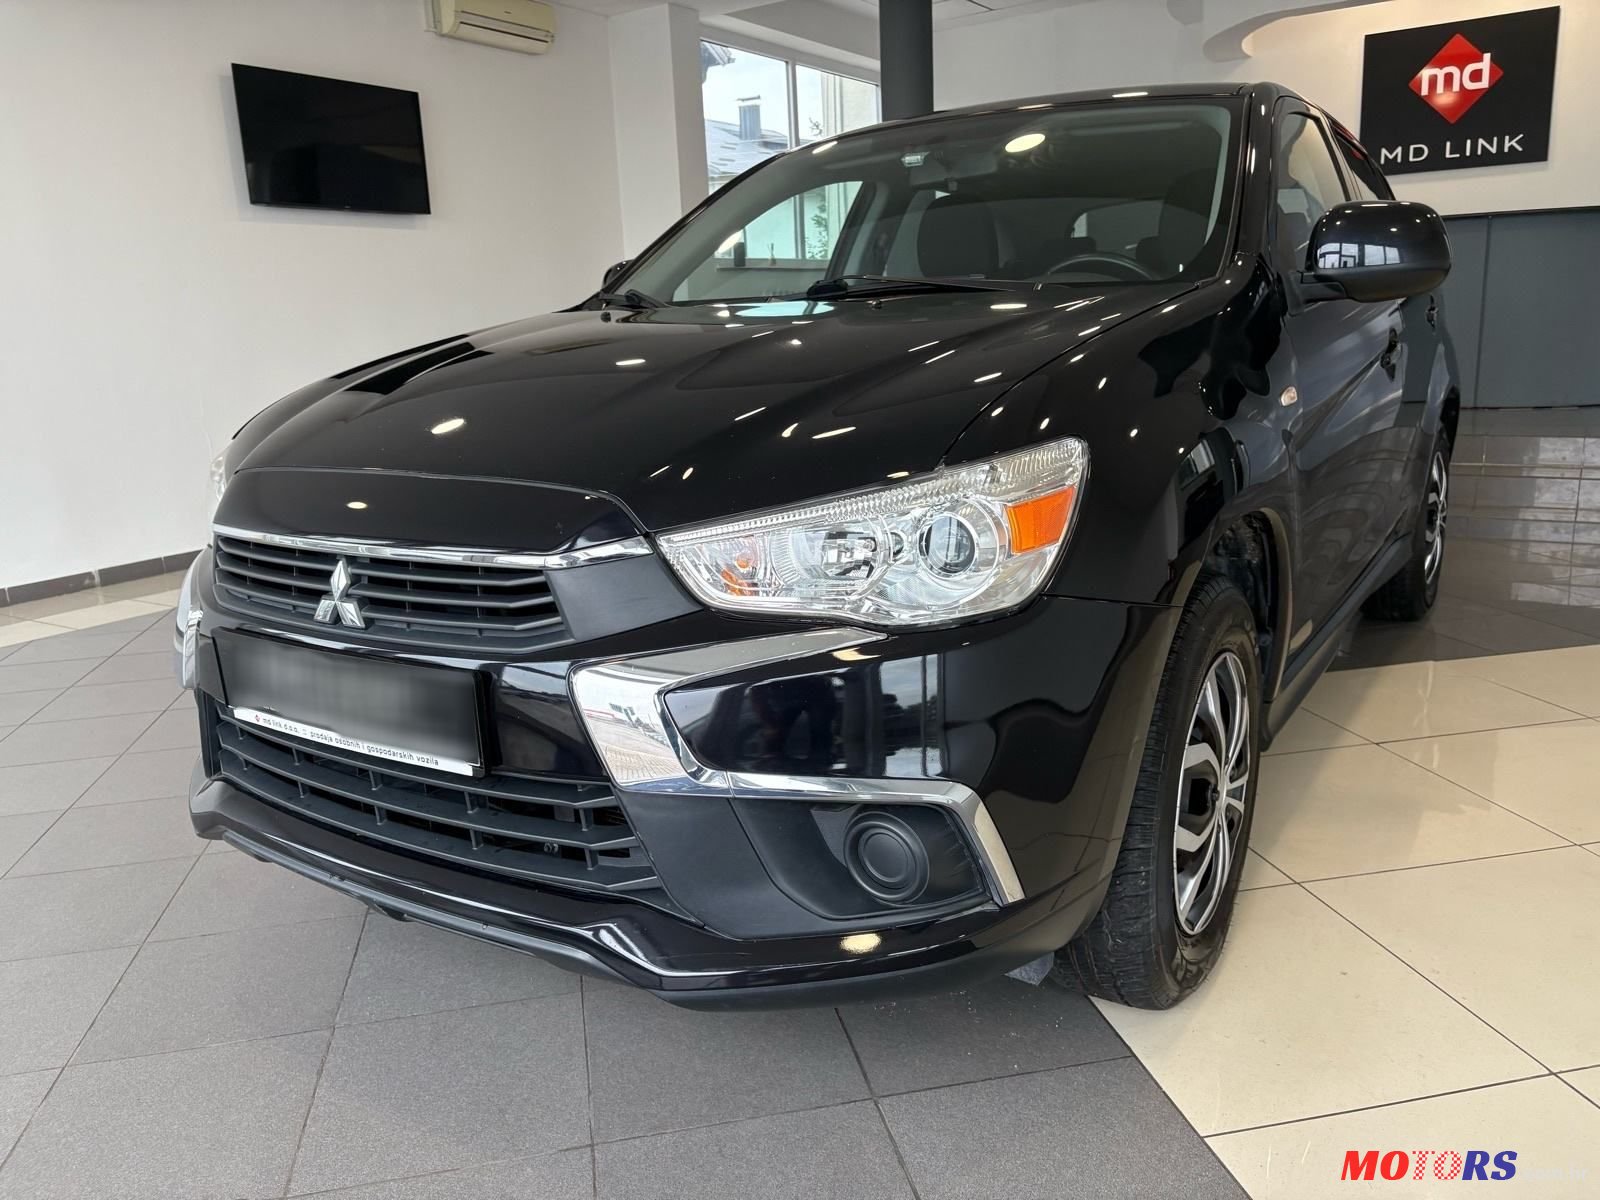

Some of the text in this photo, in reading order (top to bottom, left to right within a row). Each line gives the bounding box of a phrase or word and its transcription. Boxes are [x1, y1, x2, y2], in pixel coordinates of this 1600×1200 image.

[1420, 52, 1492, 97] md
[1380, 133, 1524, 165] MD LINK
[272, 719, 282, 729] link
[310, 731, 333, 743] prodaja
[335, 737, 361, 750] osobnih
[366, 745, 415, 761] gospodarskih
[416, 754, 439, 766] vozila
